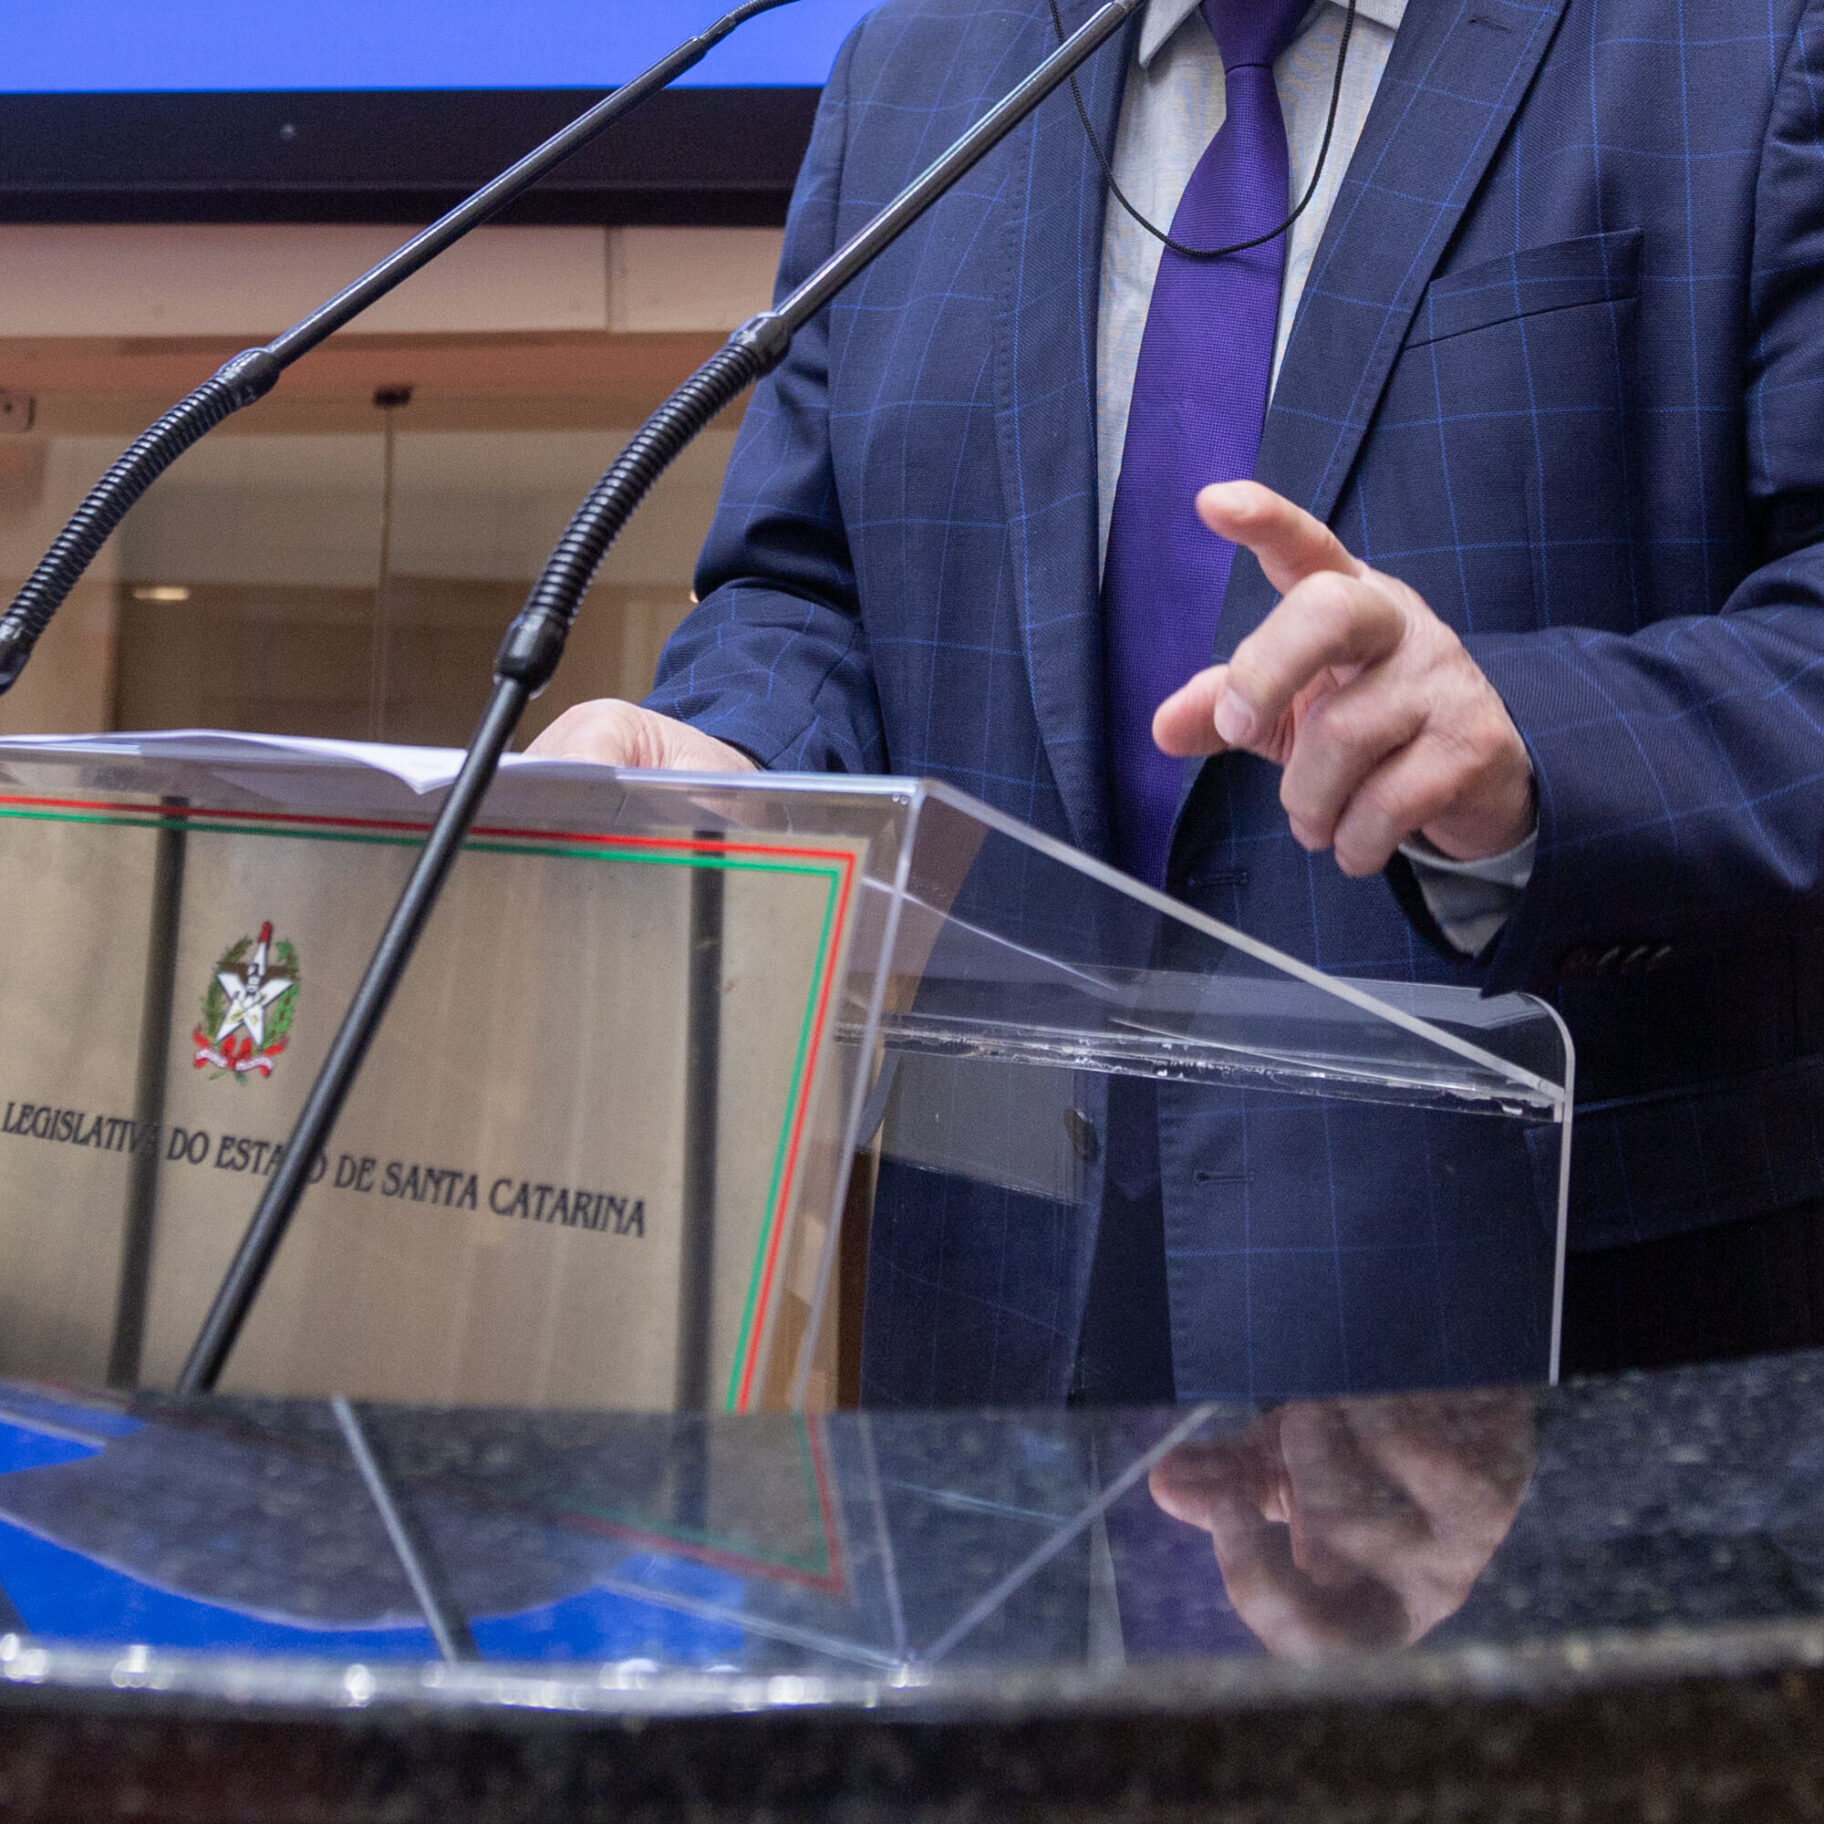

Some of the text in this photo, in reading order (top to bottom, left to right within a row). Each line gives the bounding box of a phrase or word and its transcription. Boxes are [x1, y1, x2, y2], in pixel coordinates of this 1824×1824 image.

[165, 1127, 210, 1165] DO
[214, 1136, 328, 1185] ESTAO
[332, 1153, 378, 1193] DE
[380, 1161, 479, 1211] SANTA
[489, 1178, 645, 1238] CATARINA
